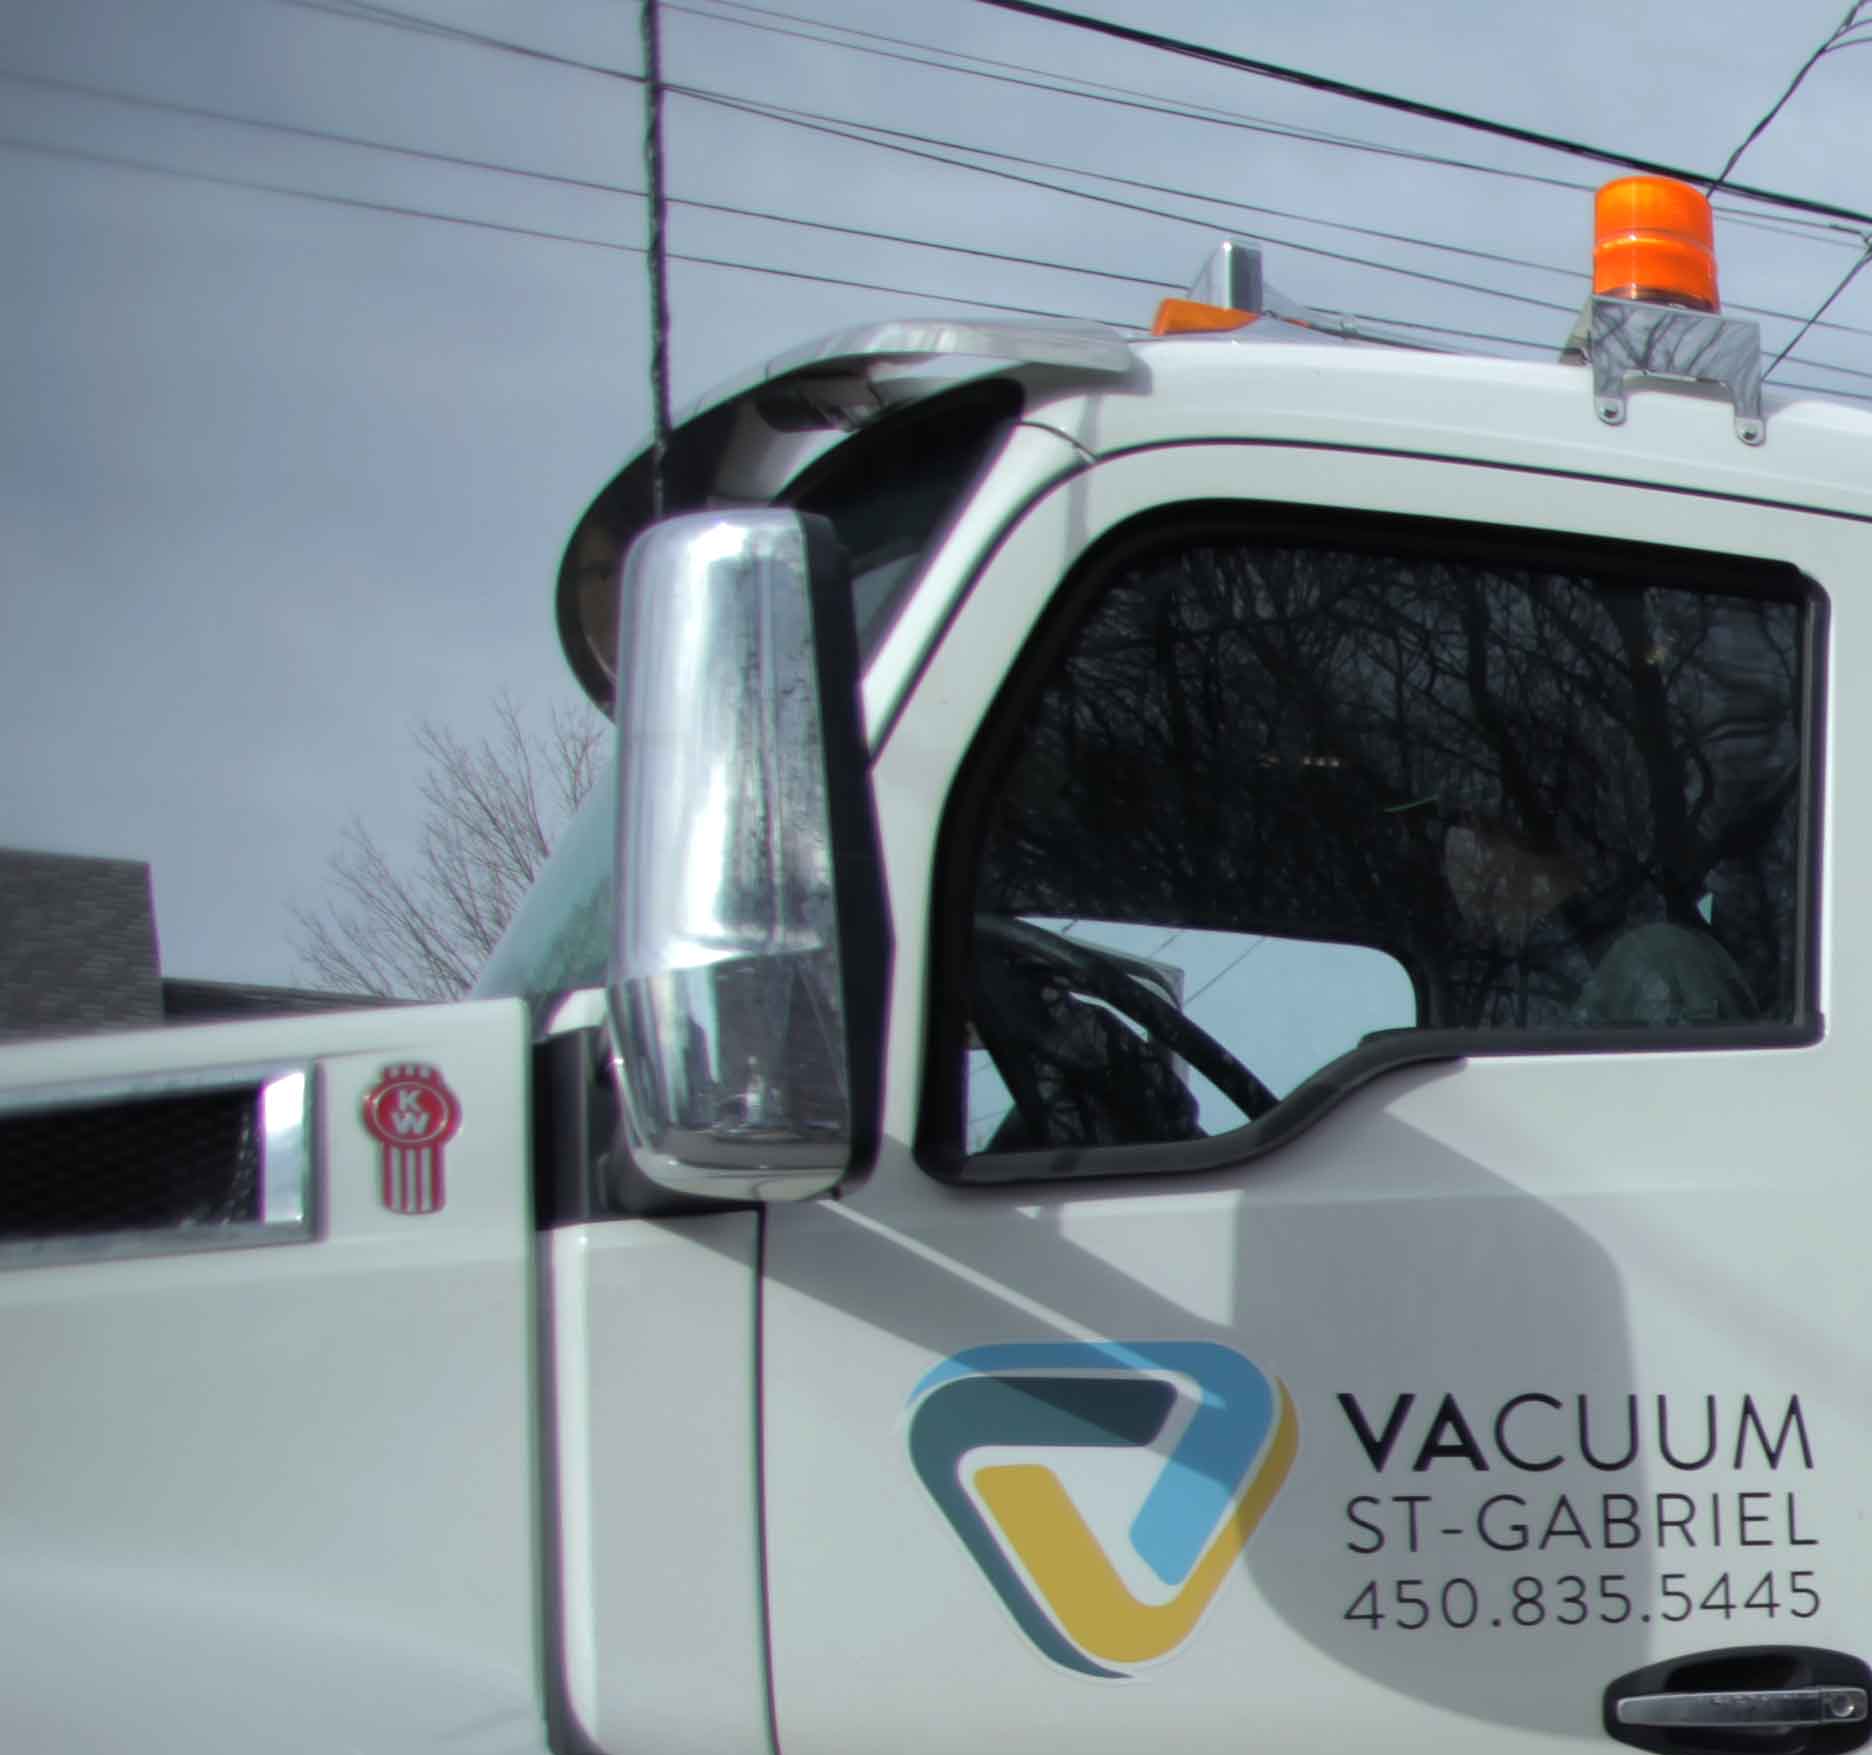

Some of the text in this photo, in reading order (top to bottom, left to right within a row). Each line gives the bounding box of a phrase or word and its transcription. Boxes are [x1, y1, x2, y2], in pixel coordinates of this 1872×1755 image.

[1336, 1391, 1816, 1472] VACUUM
[1347, 1491, 1819, 1554] ST-GABRIEL
[1342, 1569, 1822, 1631] 450.835.5445
